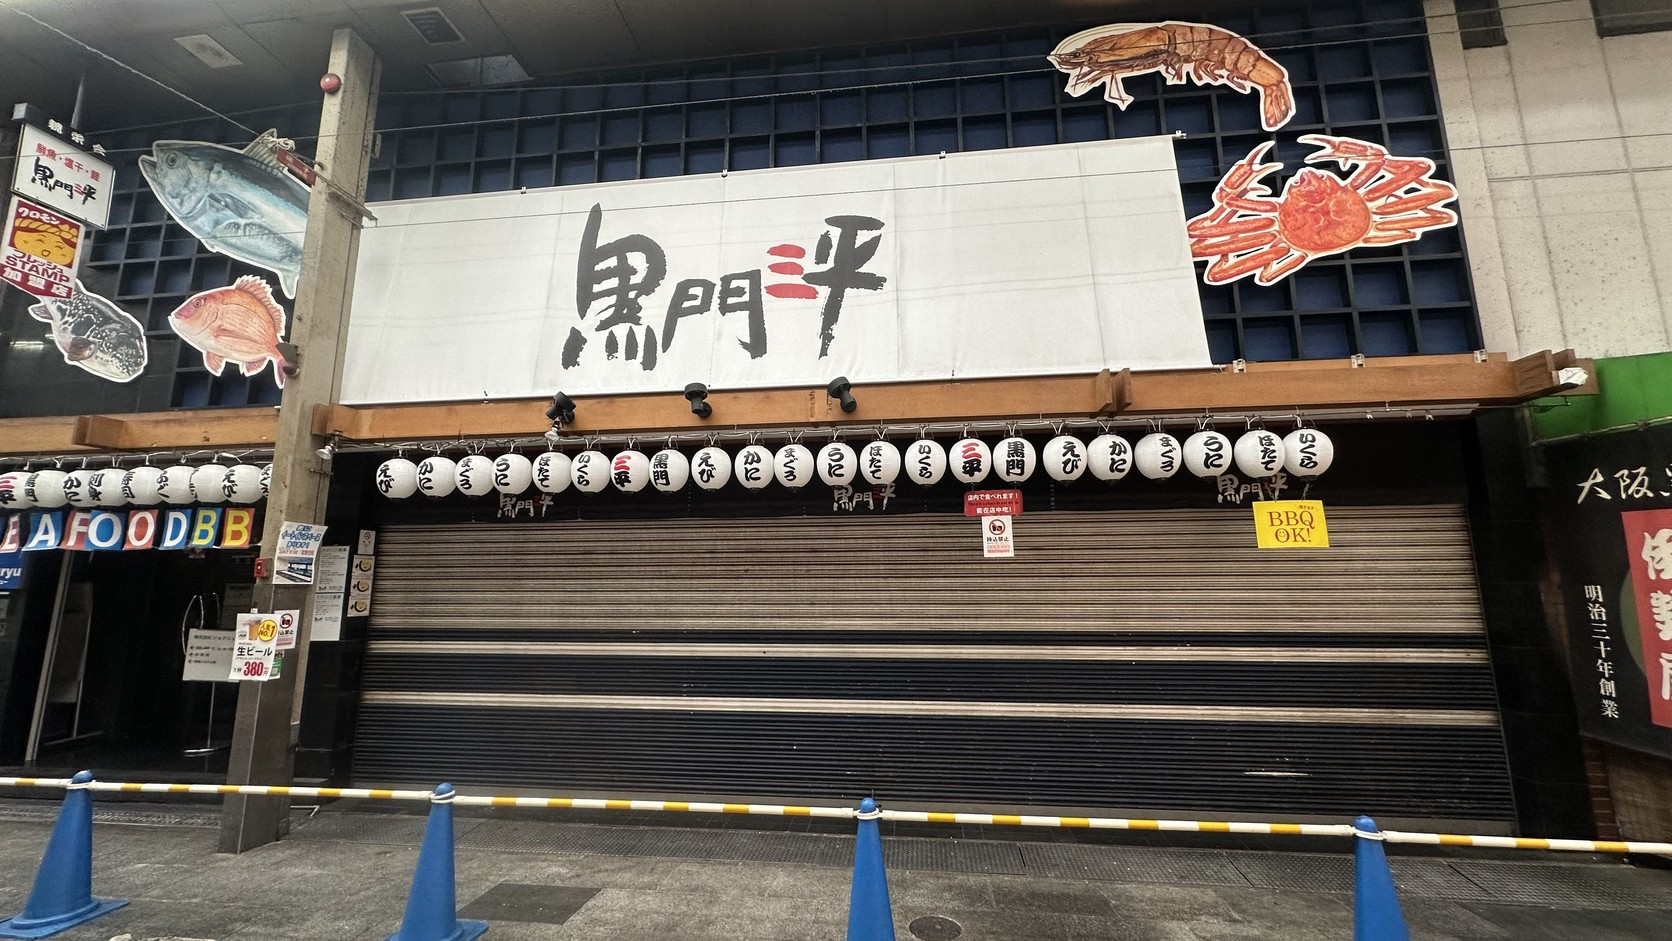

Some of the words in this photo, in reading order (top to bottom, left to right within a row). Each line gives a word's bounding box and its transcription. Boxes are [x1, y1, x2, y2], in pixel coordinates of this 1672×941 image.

[18, 207, 60, 224] クロモン
[6, 255, 70, 283] STAMP
[13, 249, 64, 274] フレッシュ
[3, 267, 69, 297] 加盟店
[561, 202, 888, 371] 黒門三平
[744, 450, 761, 481] かに
[783, 447, 797, 481] まぐろ
[827, 447, 845, 477] うに
[869, 446, 882, 480] ほたて
[918, 444, 932, 478] いくら
[962, 442, 982, 477] 三平
[1006, 441, 1025, 476] 黒門
[1062, 441, 1081, 474] えび
[1109, 441, 1127, 473] かに
[1159, 436, 1176, 472] まぐろ
[1203, 436, 1223, 469] うに
[1258, 435, 1276, 471] ほたて
[1299, 433, 1318, 469] いくら
[222, 469, 239, 498] えび
[378, 465, 394, 493] えび
[419, 462, 434, 490] かに
[459, 458, 474, 489] まぐろ
[495, 458, 510, 487] うに
[538, 456, 551, 488] ほたて
[576, 454, 590, 486] いくら
[614, 455, 631, 487] 三平
[653, 454, 670, 486] 黒門
[698, 452, 717, 483] えび
[63, 477, 82, 502] かに
[1267, 510, 1315, 530] BBQ
[1275, 527, 1311, 543] OK!
[236, 646, 273, 657] 生ビール
[1584, 584, 1619, 719] 明治三十年創業
